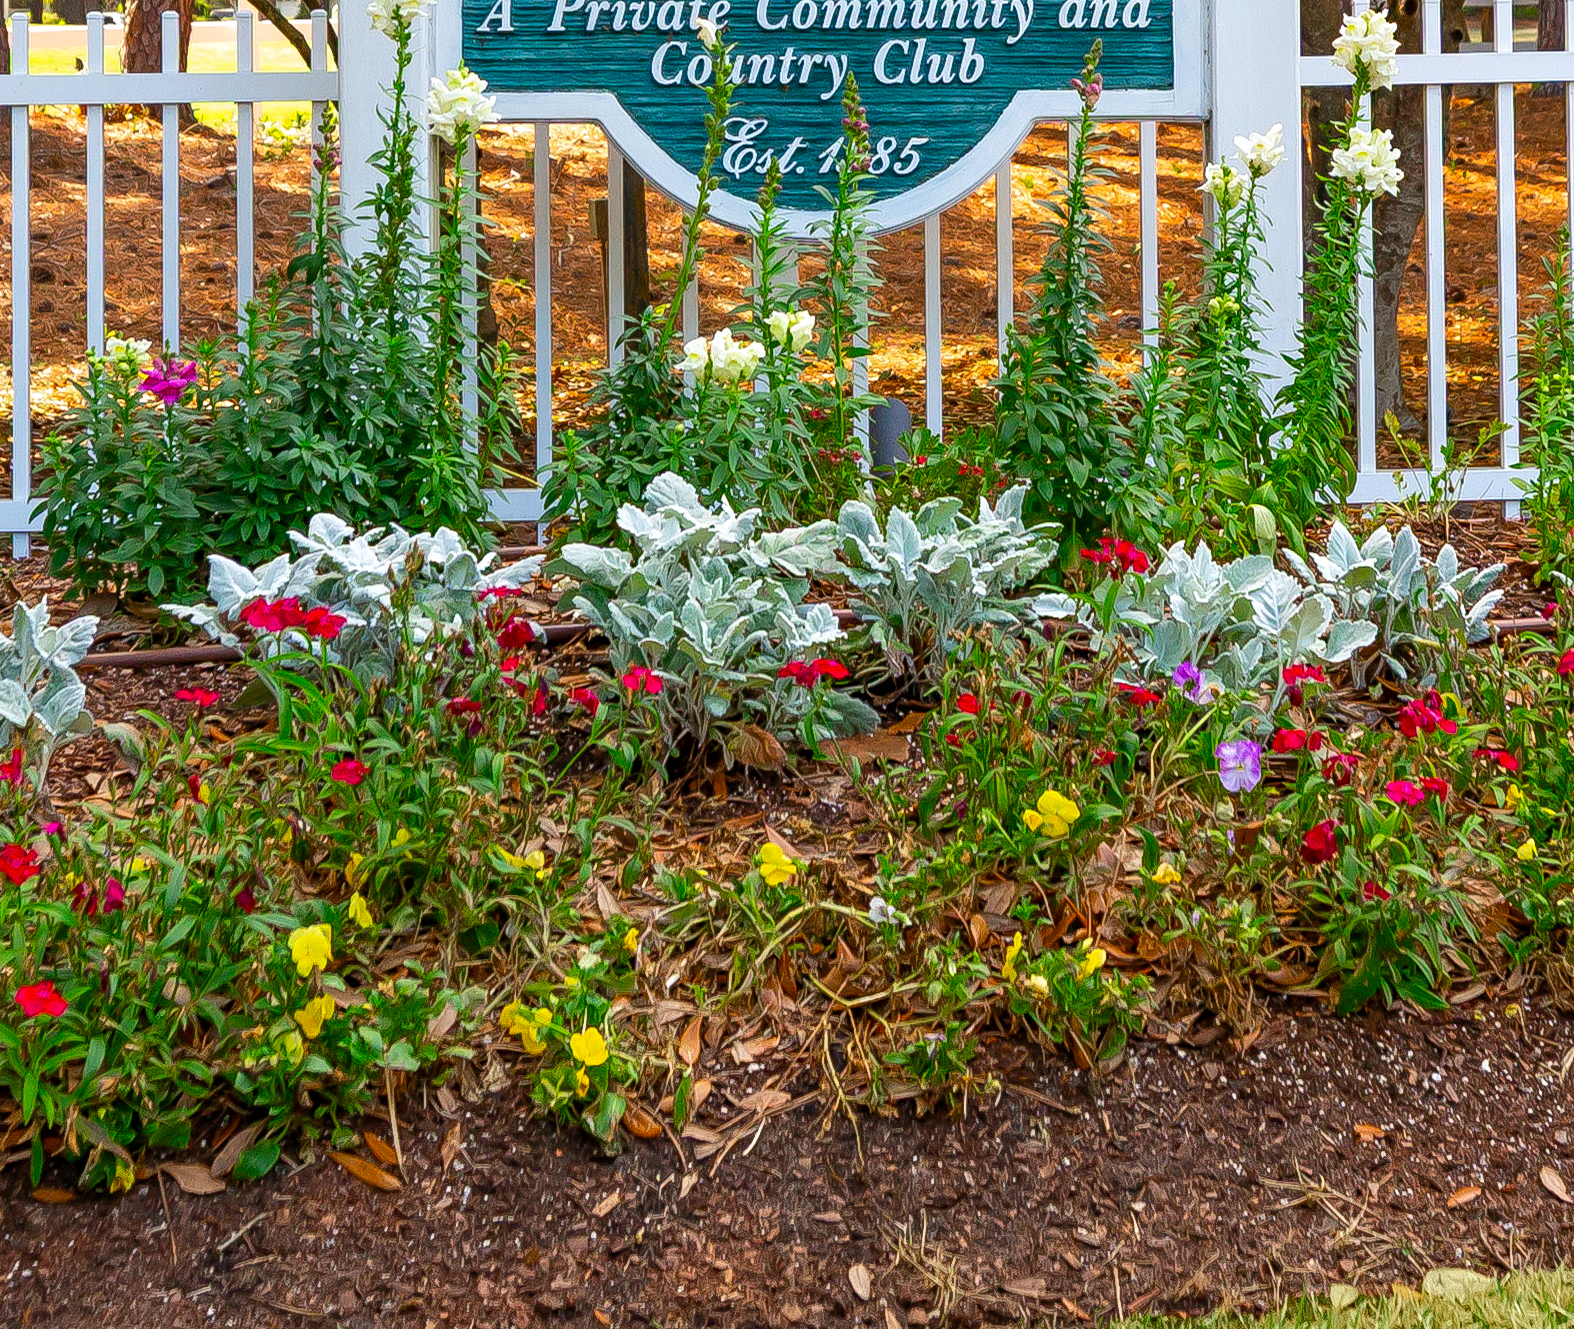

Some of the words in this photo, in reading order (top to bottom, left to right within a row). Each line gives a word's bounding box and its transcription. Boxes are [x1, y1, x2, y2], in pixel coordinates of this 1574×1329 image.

[651, 40, 849, 100] Country
[873, 37, 986, 85] Club
[722, 117, 808, 180] Est.
[818, 136, 931, 175] 185
